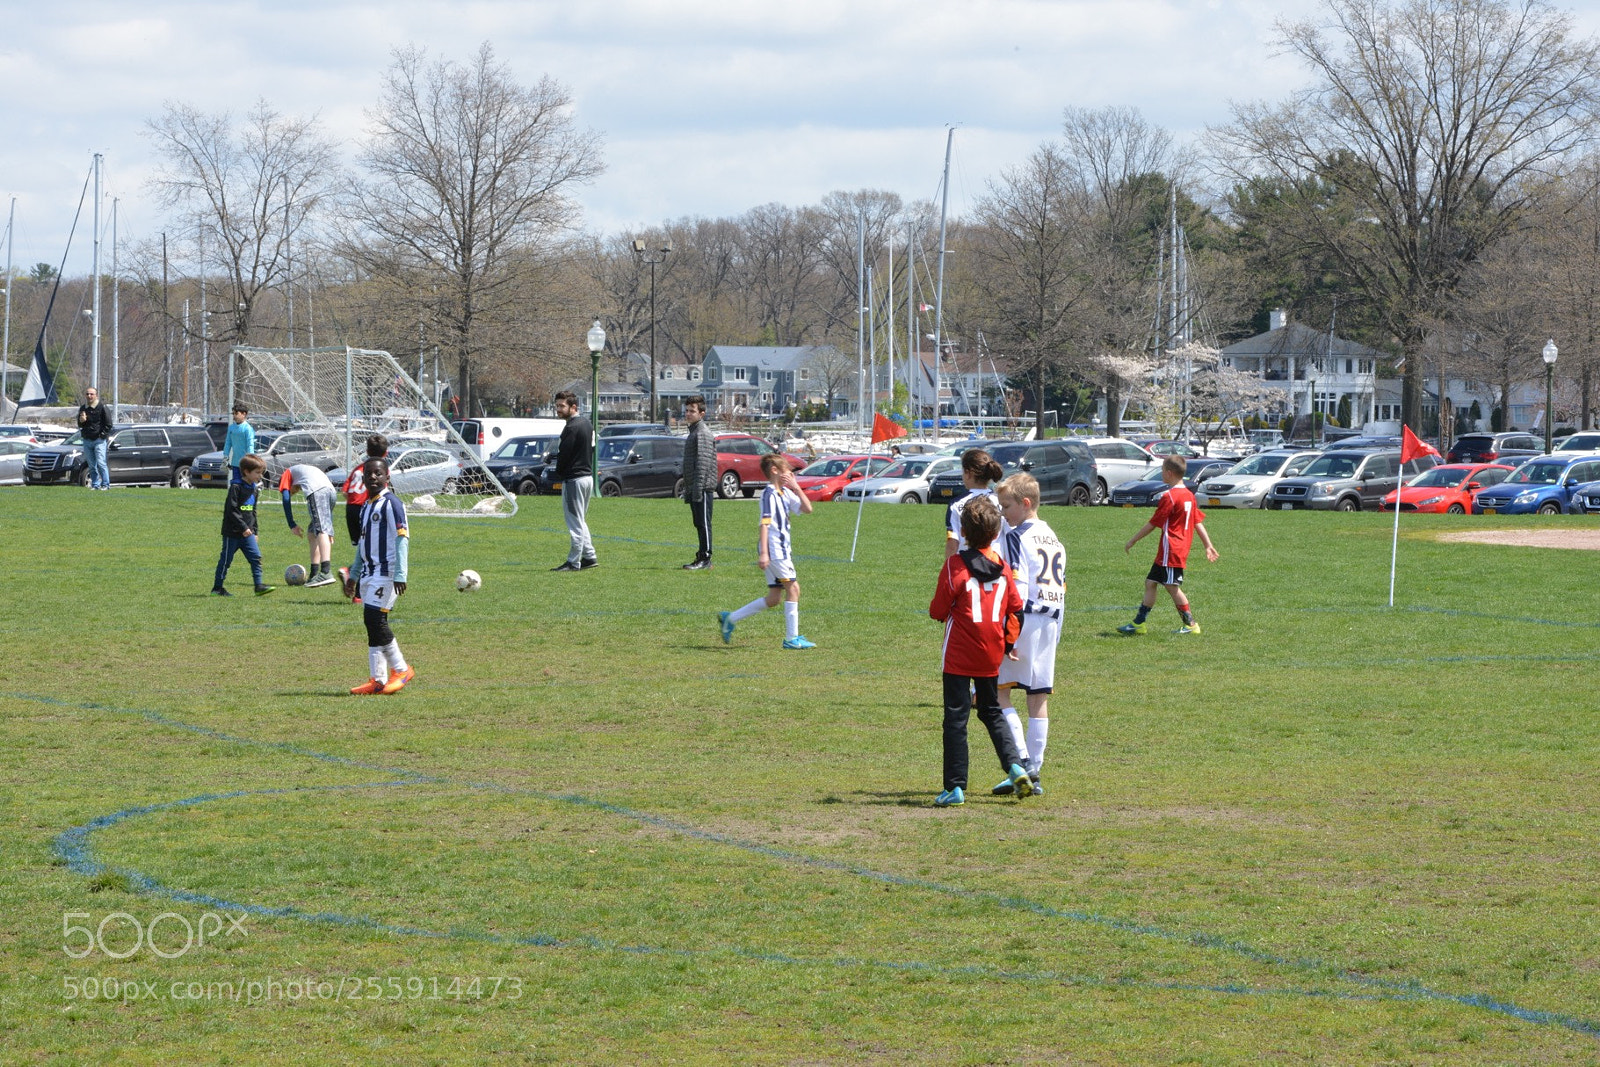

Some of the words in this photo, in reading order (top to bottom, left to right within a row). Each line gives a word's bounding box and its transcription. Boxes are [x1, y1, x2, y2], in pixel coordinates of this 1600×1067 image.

[1036, 548, 1063, 586] 26
[374, 586, 384, 599] 4
[966, 575, 1008, 622] 17
